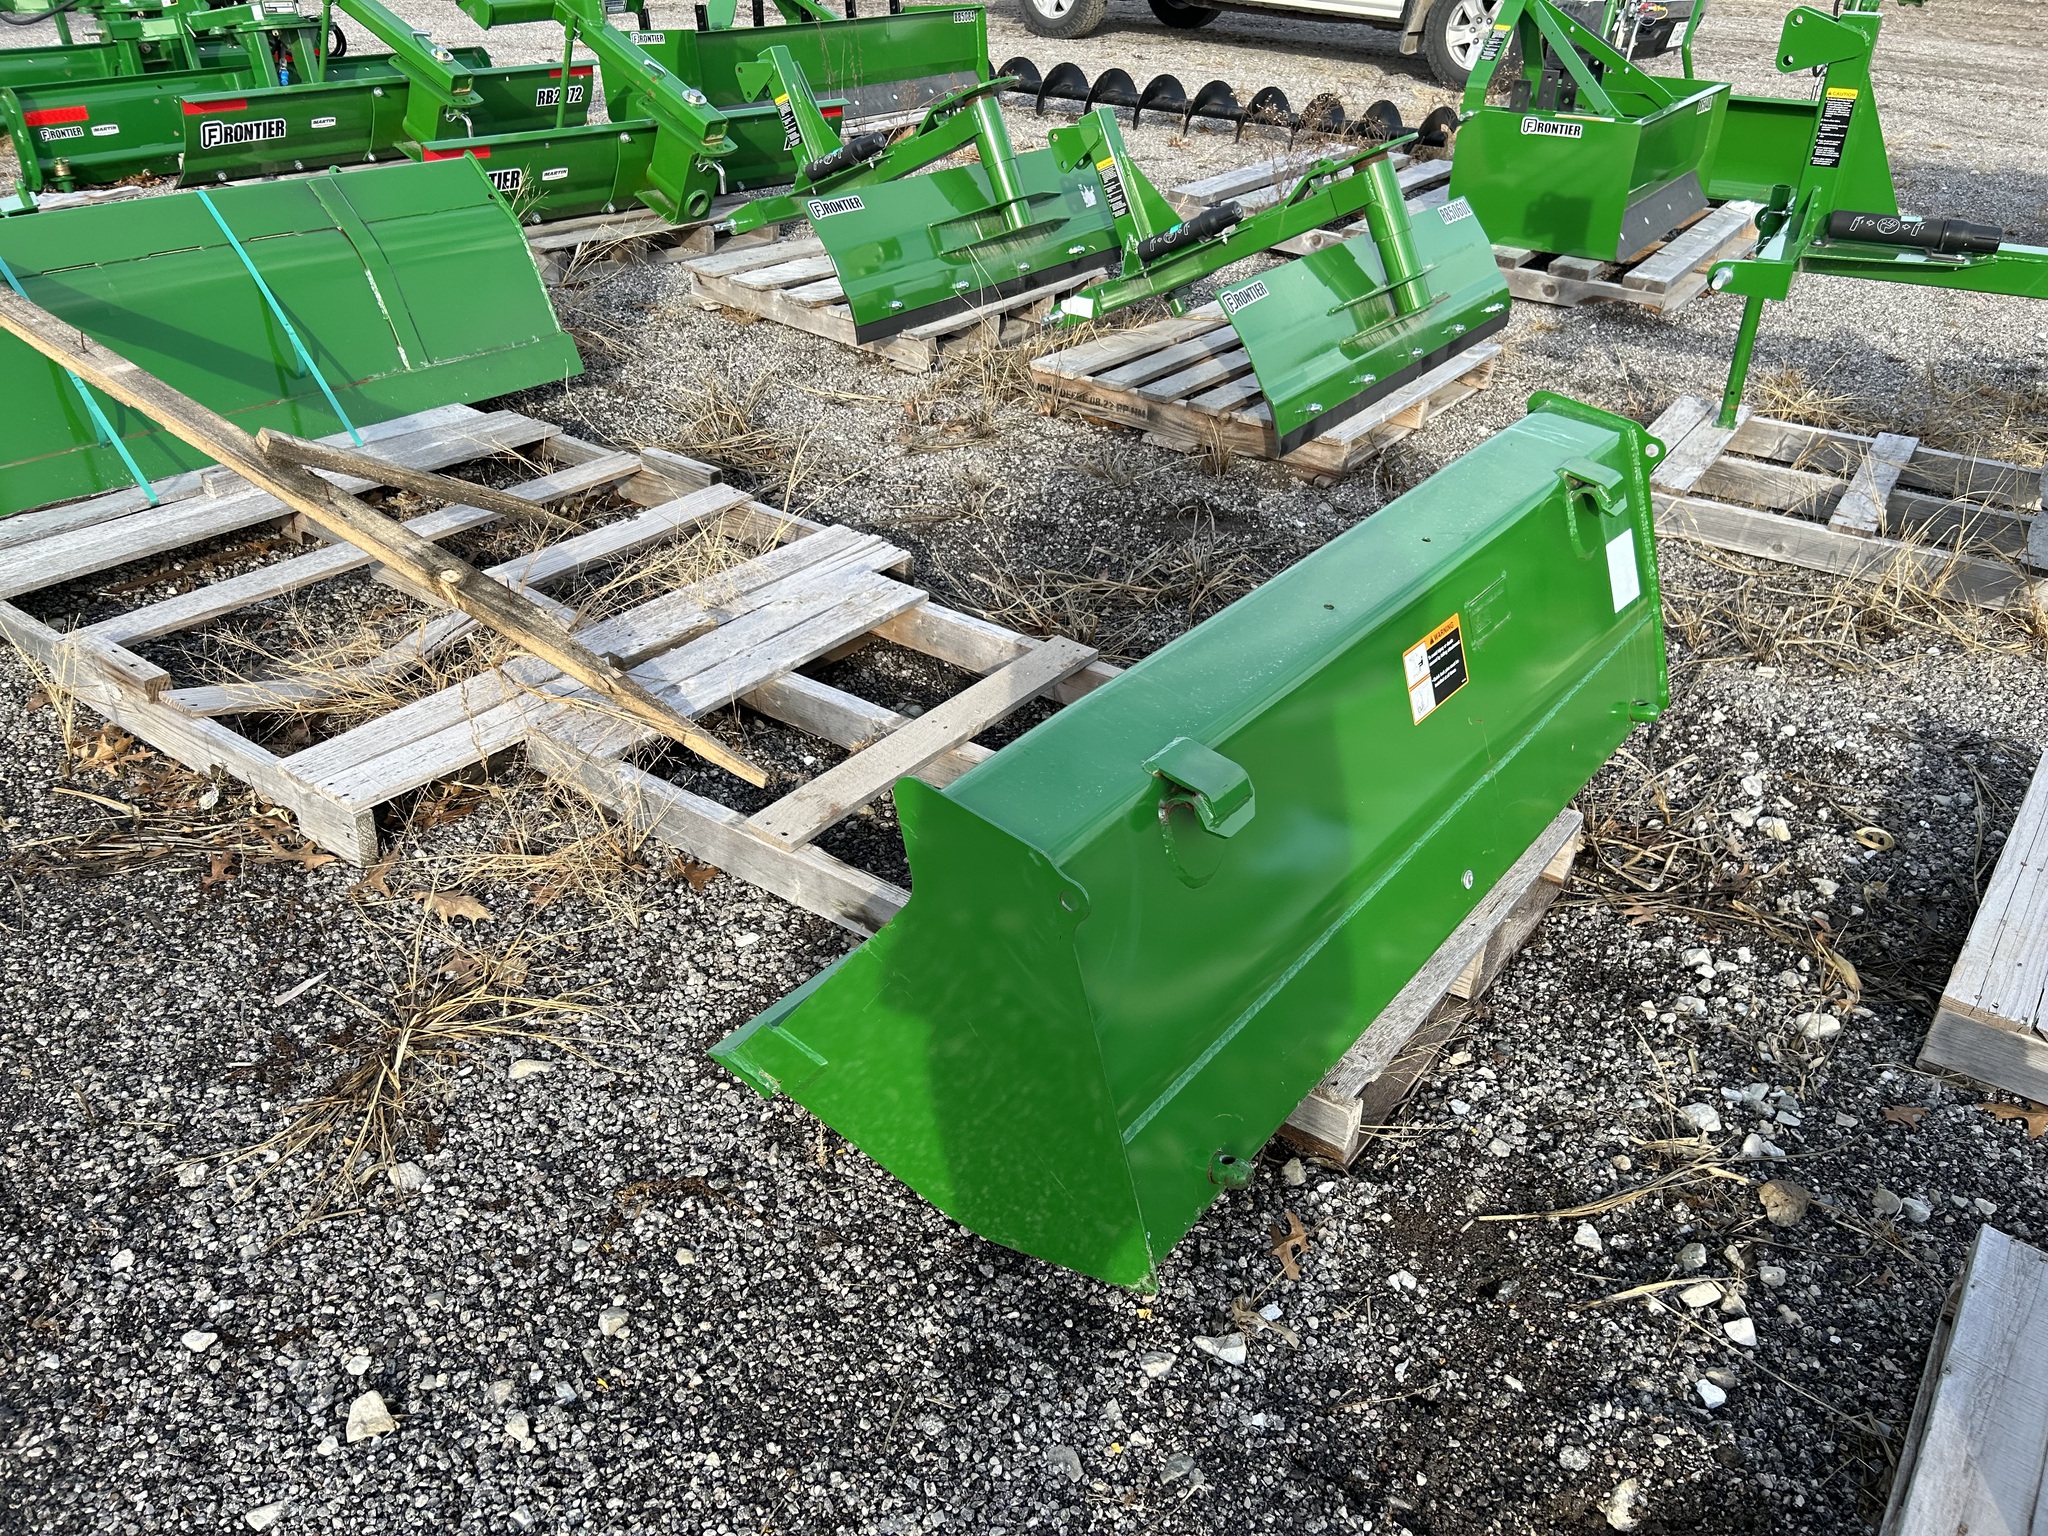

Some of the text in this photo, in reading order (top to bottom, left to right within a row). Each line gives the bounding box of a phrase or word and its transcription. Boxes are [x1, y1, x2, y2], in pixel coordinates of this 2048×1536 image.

[631, 33, 664, 44] FRONTIER
[537, 86, 583, 106] RB272
[40, 127, 83, 142] FRONTIER
[202, 120, 285, 148] FRONTIER
[1522, 118, 1581, 136] FRONTIER
[488, 170, 521, 190] TIER
[809, 196, 863, 218] FRONTIER
[1222, 282, 1268, 313] FRONTIER
[1433, 621, 1454, 640] WARNING
